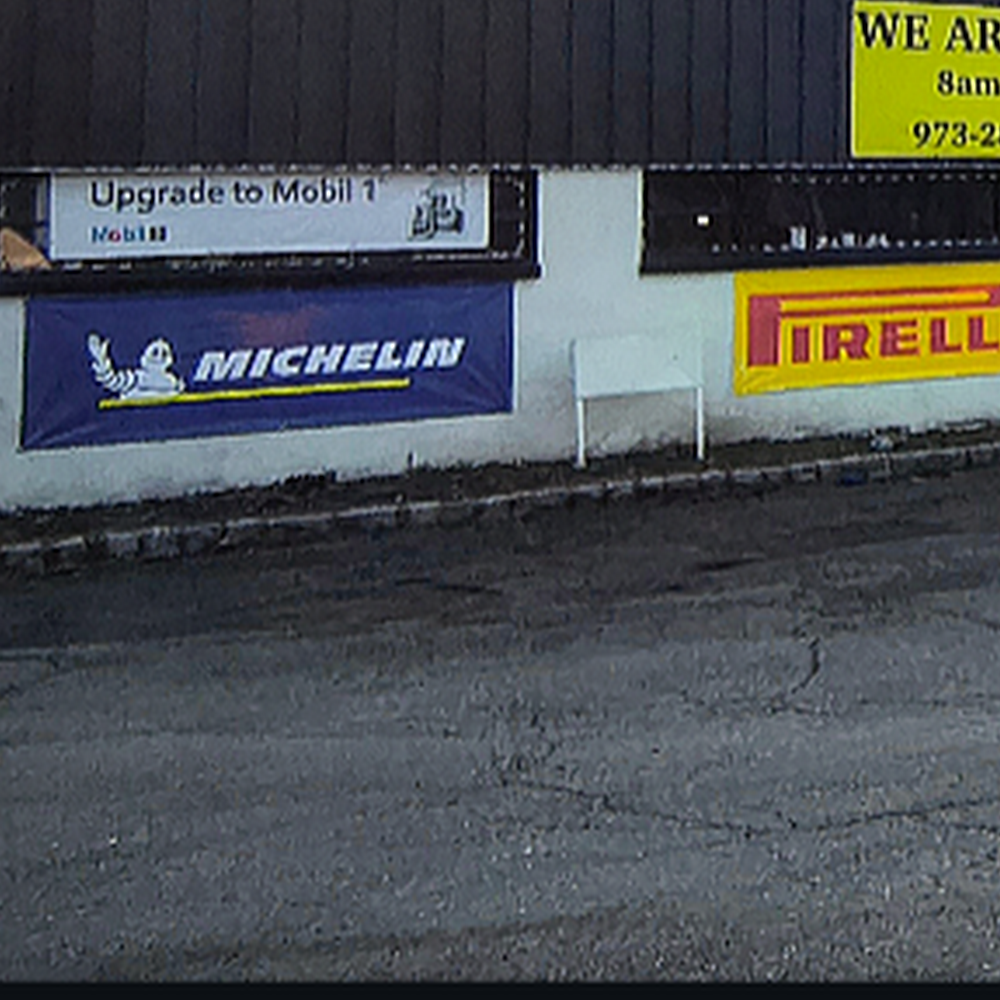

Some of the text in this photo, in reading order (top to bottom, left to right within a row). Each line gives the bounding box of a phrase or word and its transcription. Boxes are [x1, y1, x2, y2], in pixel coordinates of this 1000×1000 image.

[857, 11, 930, 50] WE
[937, 70, 1000, 96] 8am
[91, 177, 375, 213] Upgrade to Mobil 1
[91, 225, 145, 242] Mobil
[193, 337, 465, 381] MICHELIN
